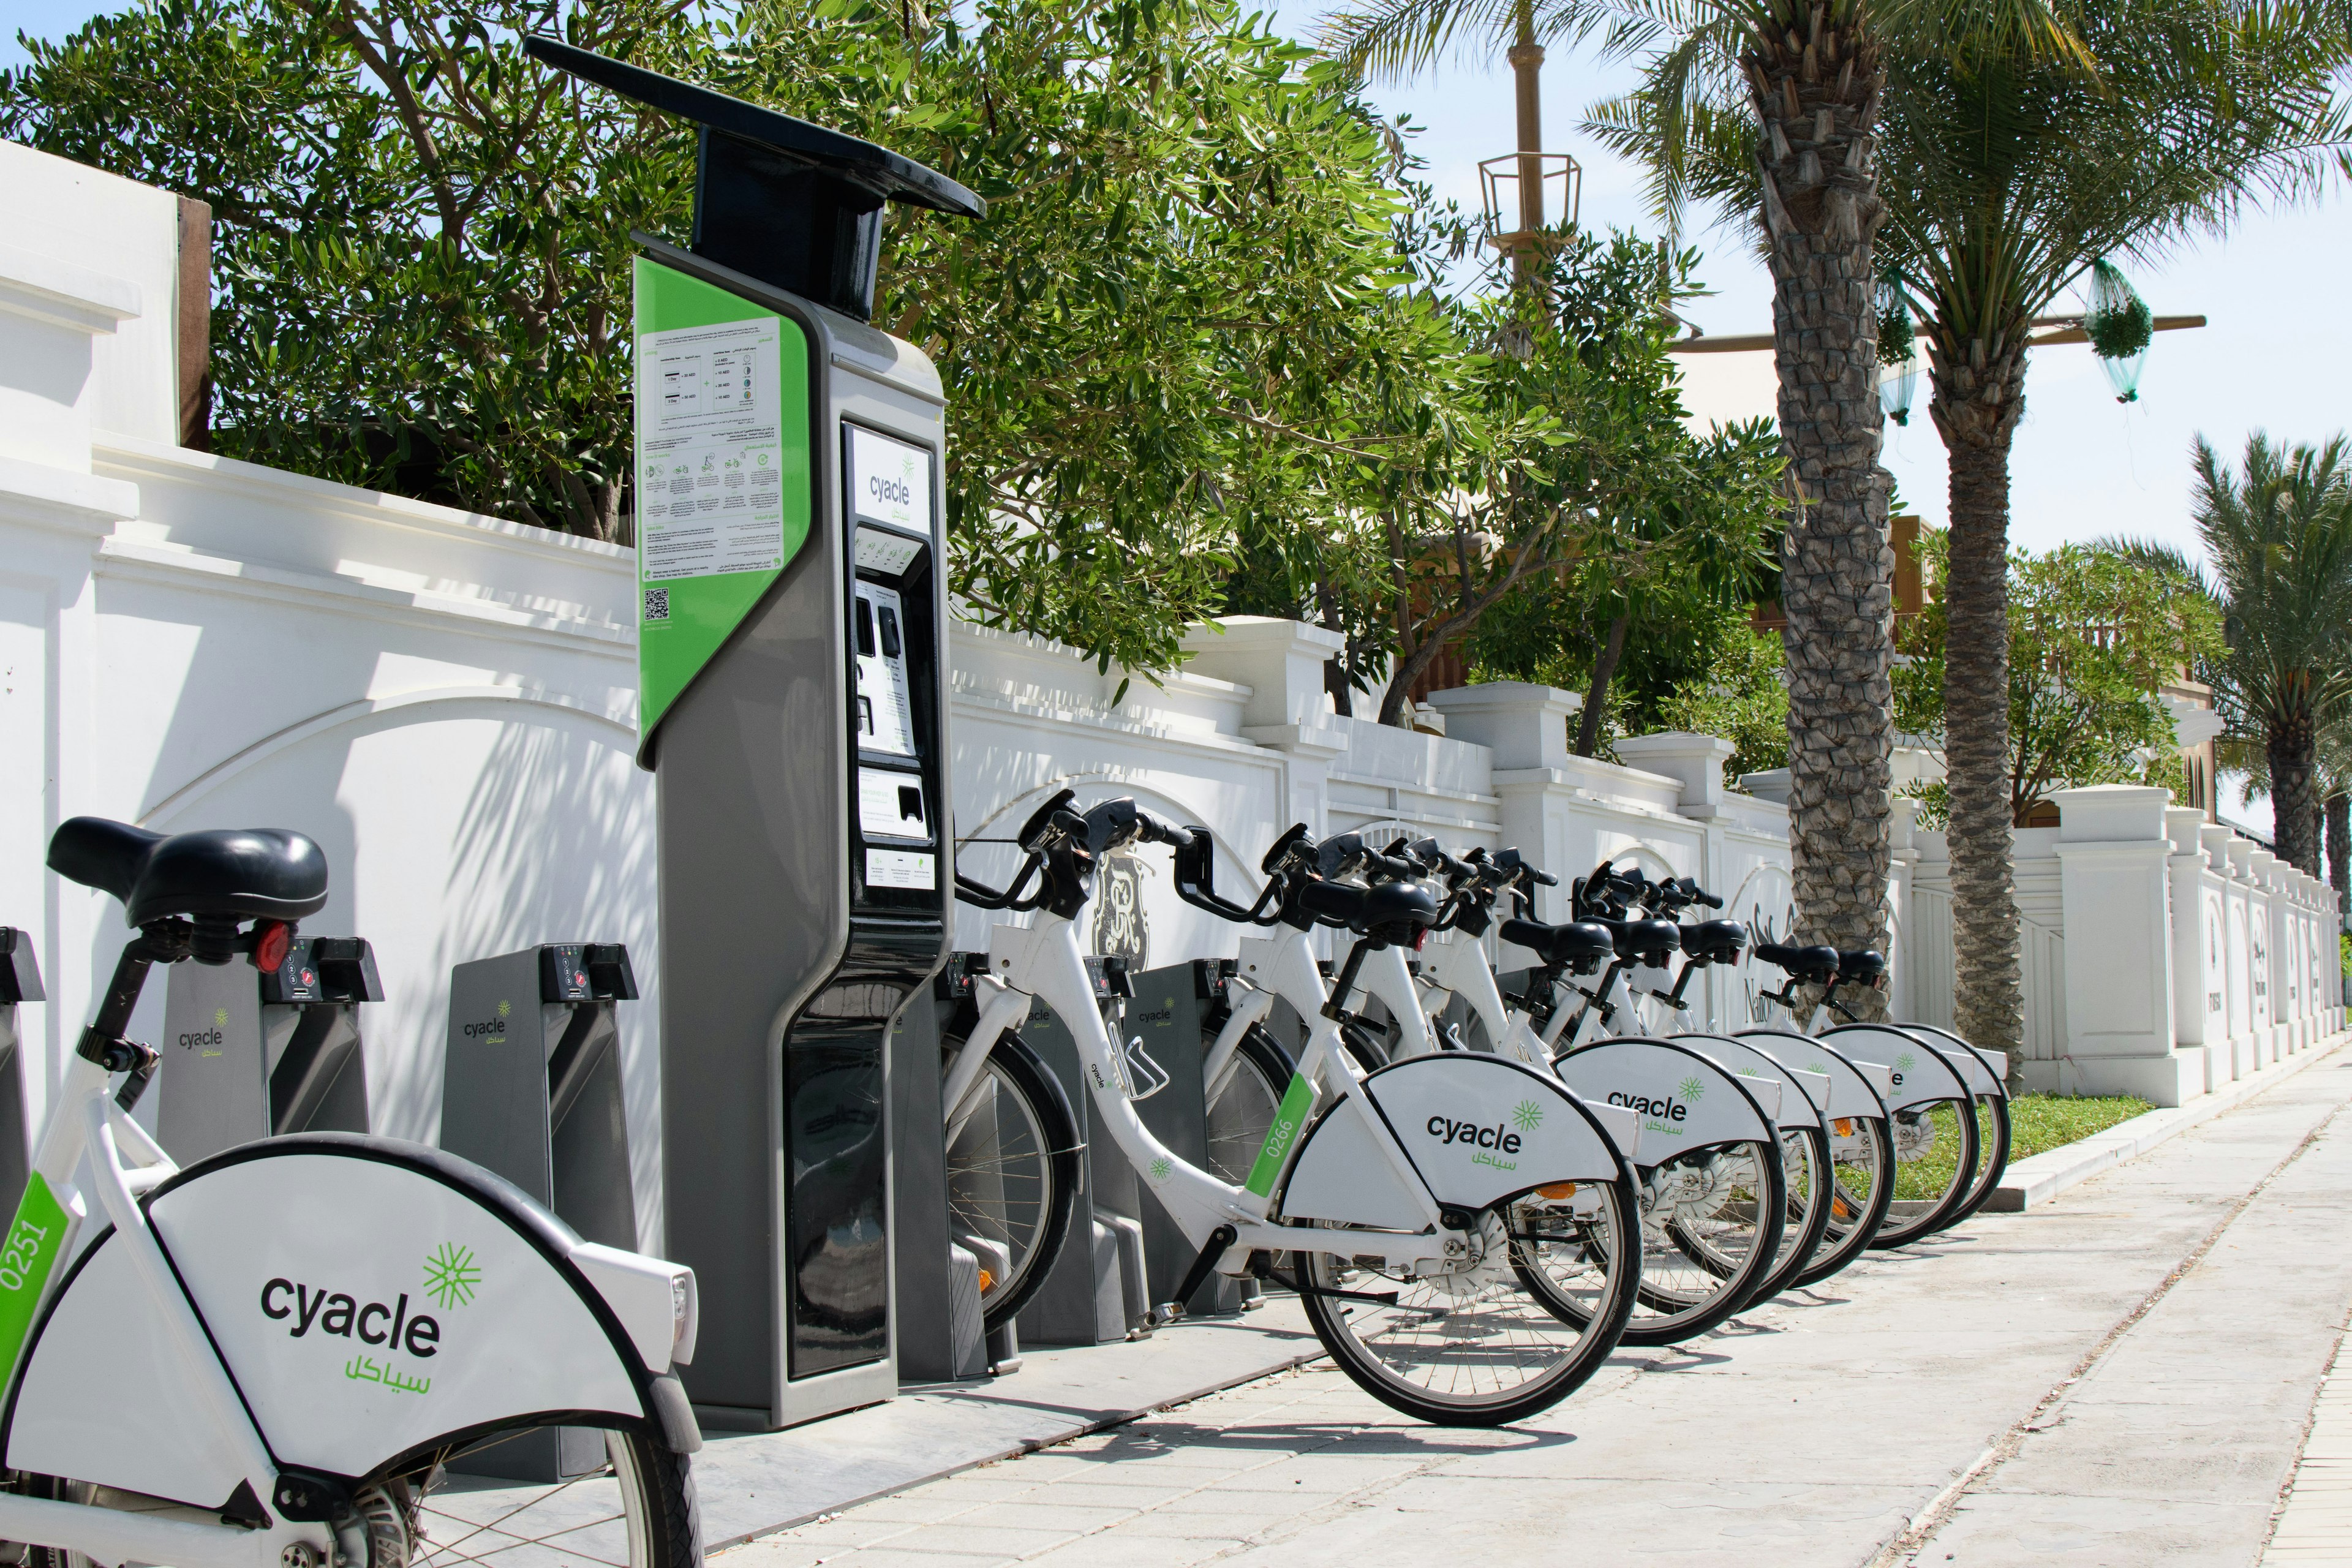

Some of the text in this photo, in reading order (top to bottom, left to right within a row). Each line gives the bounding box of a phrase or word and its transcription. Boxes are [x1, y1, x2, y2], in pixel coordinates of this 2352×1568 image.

[870, 475, 910, 505] cyacle
[464, 1017, 505, 1038] cyacle
[1139, 1009, 1170, 1023] cyacle
[179, 1027, 222, 1050] cyacle
[1091, 1063, 1104, 1088] cyacle
[1608, 1091, 1687, 1121] cyacle
[1266, 1119, 1292, 1157] 0266
[1427, 1116, 1521, 1154] cyacle
[1646, 1120, 1683, 1135] سياكل
[1472, 1152, 1517, 1170] سياكل
[0, 1220, 48, 1291] 0251
[260, 1278, 440, 1358] cyacle
[345, 1354, 431, 1394] سياكل
